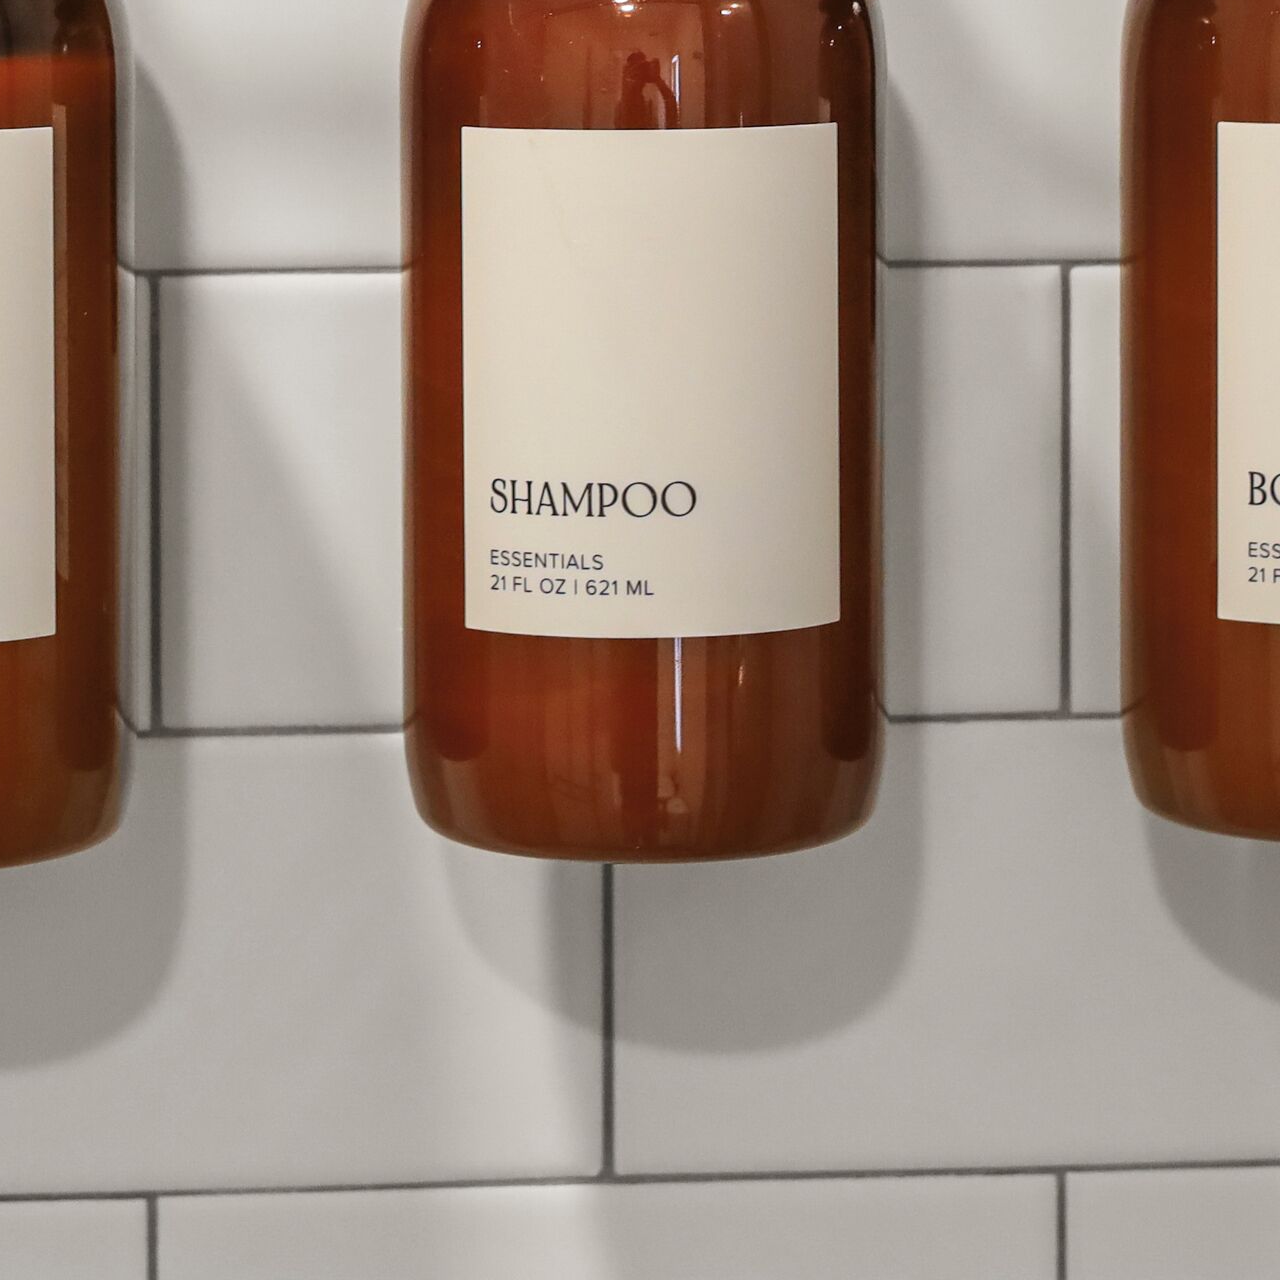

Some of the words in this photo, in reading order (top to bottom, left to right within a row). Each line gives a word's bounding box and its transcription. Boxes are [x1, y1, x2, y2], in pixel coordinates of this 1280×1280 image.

[490, 477, 698, 519] SHAMPOO
[490, 548, 604, 571] ESSENTIALS
[490, 573, 507, 591] 21
[512, 575, 533, 594] FL
[539, 577, 567, 595] OZ
[585, 579, 618, 596] 621
[626, 579, 655, 597] ML
[1247, 566, 1266, 583] 21
